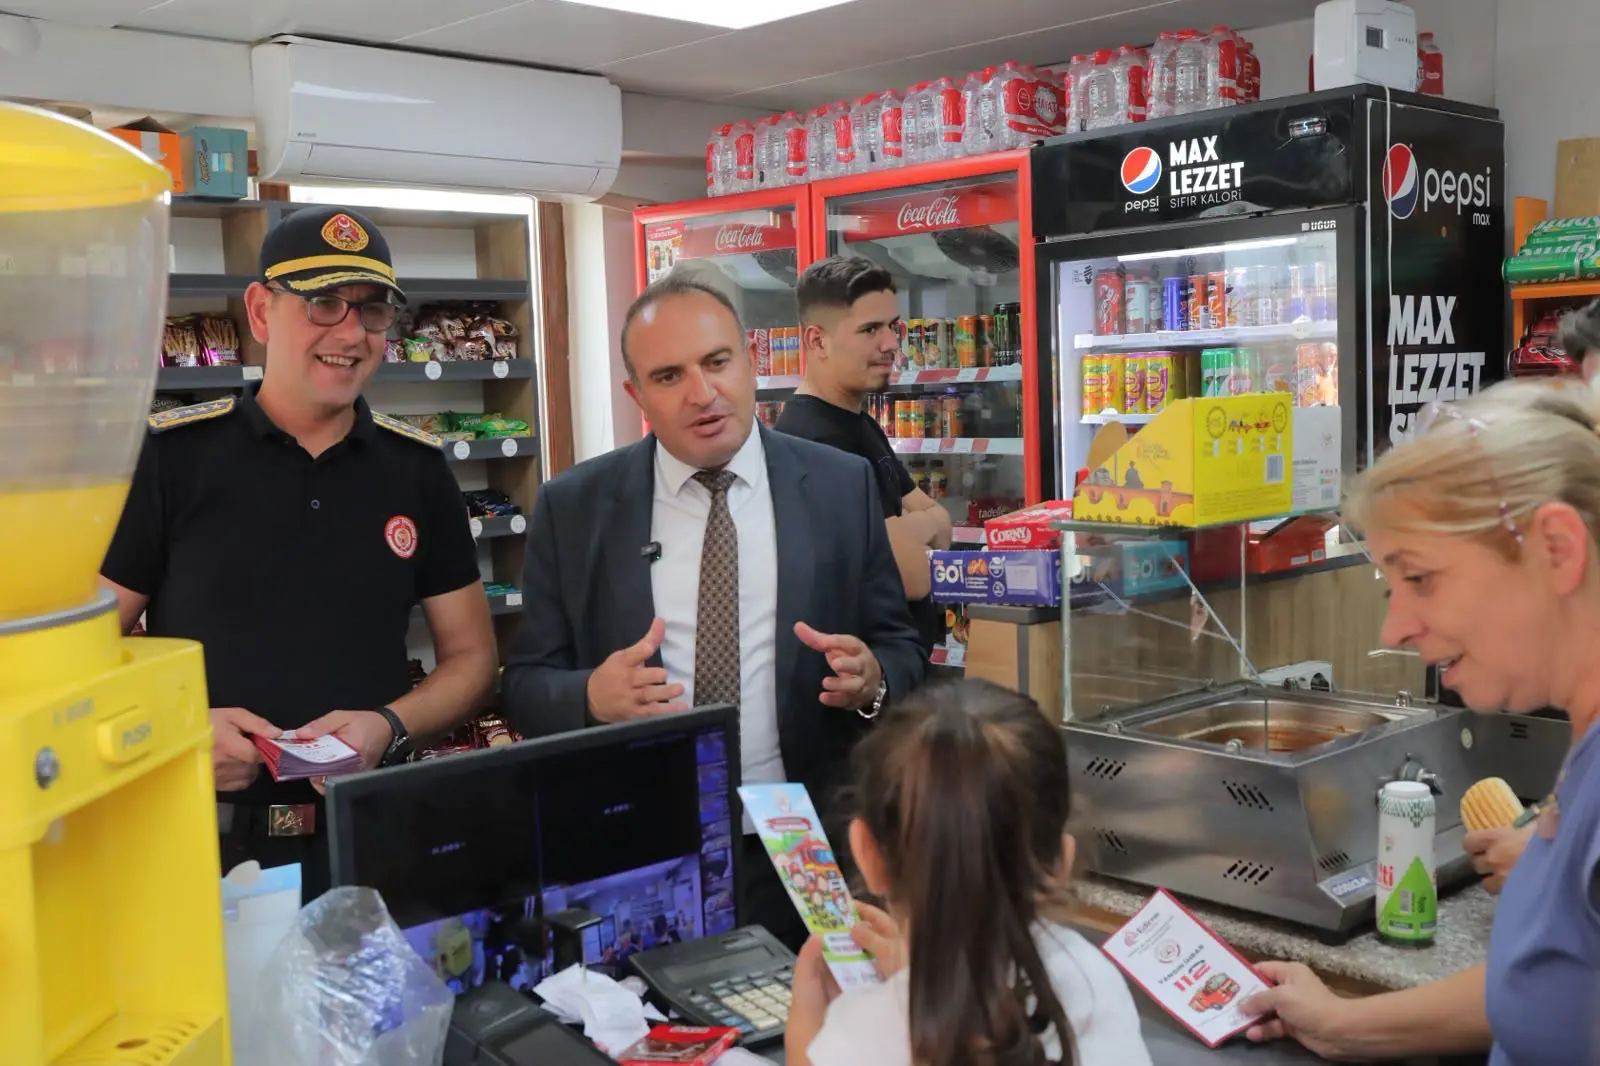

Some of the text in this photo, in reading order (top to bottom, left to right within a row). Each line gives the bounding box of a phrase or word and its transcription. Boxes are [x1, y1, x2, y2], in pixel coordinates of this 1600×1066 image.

[1169, 135, 1219, 167] MAX
[1170, 161, 1244, 196] LEZZET
[1424, 166, 1490, 216] pepsi
[1125, 196, 1159, 213] pepsi
[1170, 196, 1197, 209] SIFIR
[1472, 212, 1491, 225] max
[1386, 294, 1457, 346] MAX
[1388, 352, 1486, 405] LEZZET
[990, 526, 1027, 544] CORNY
